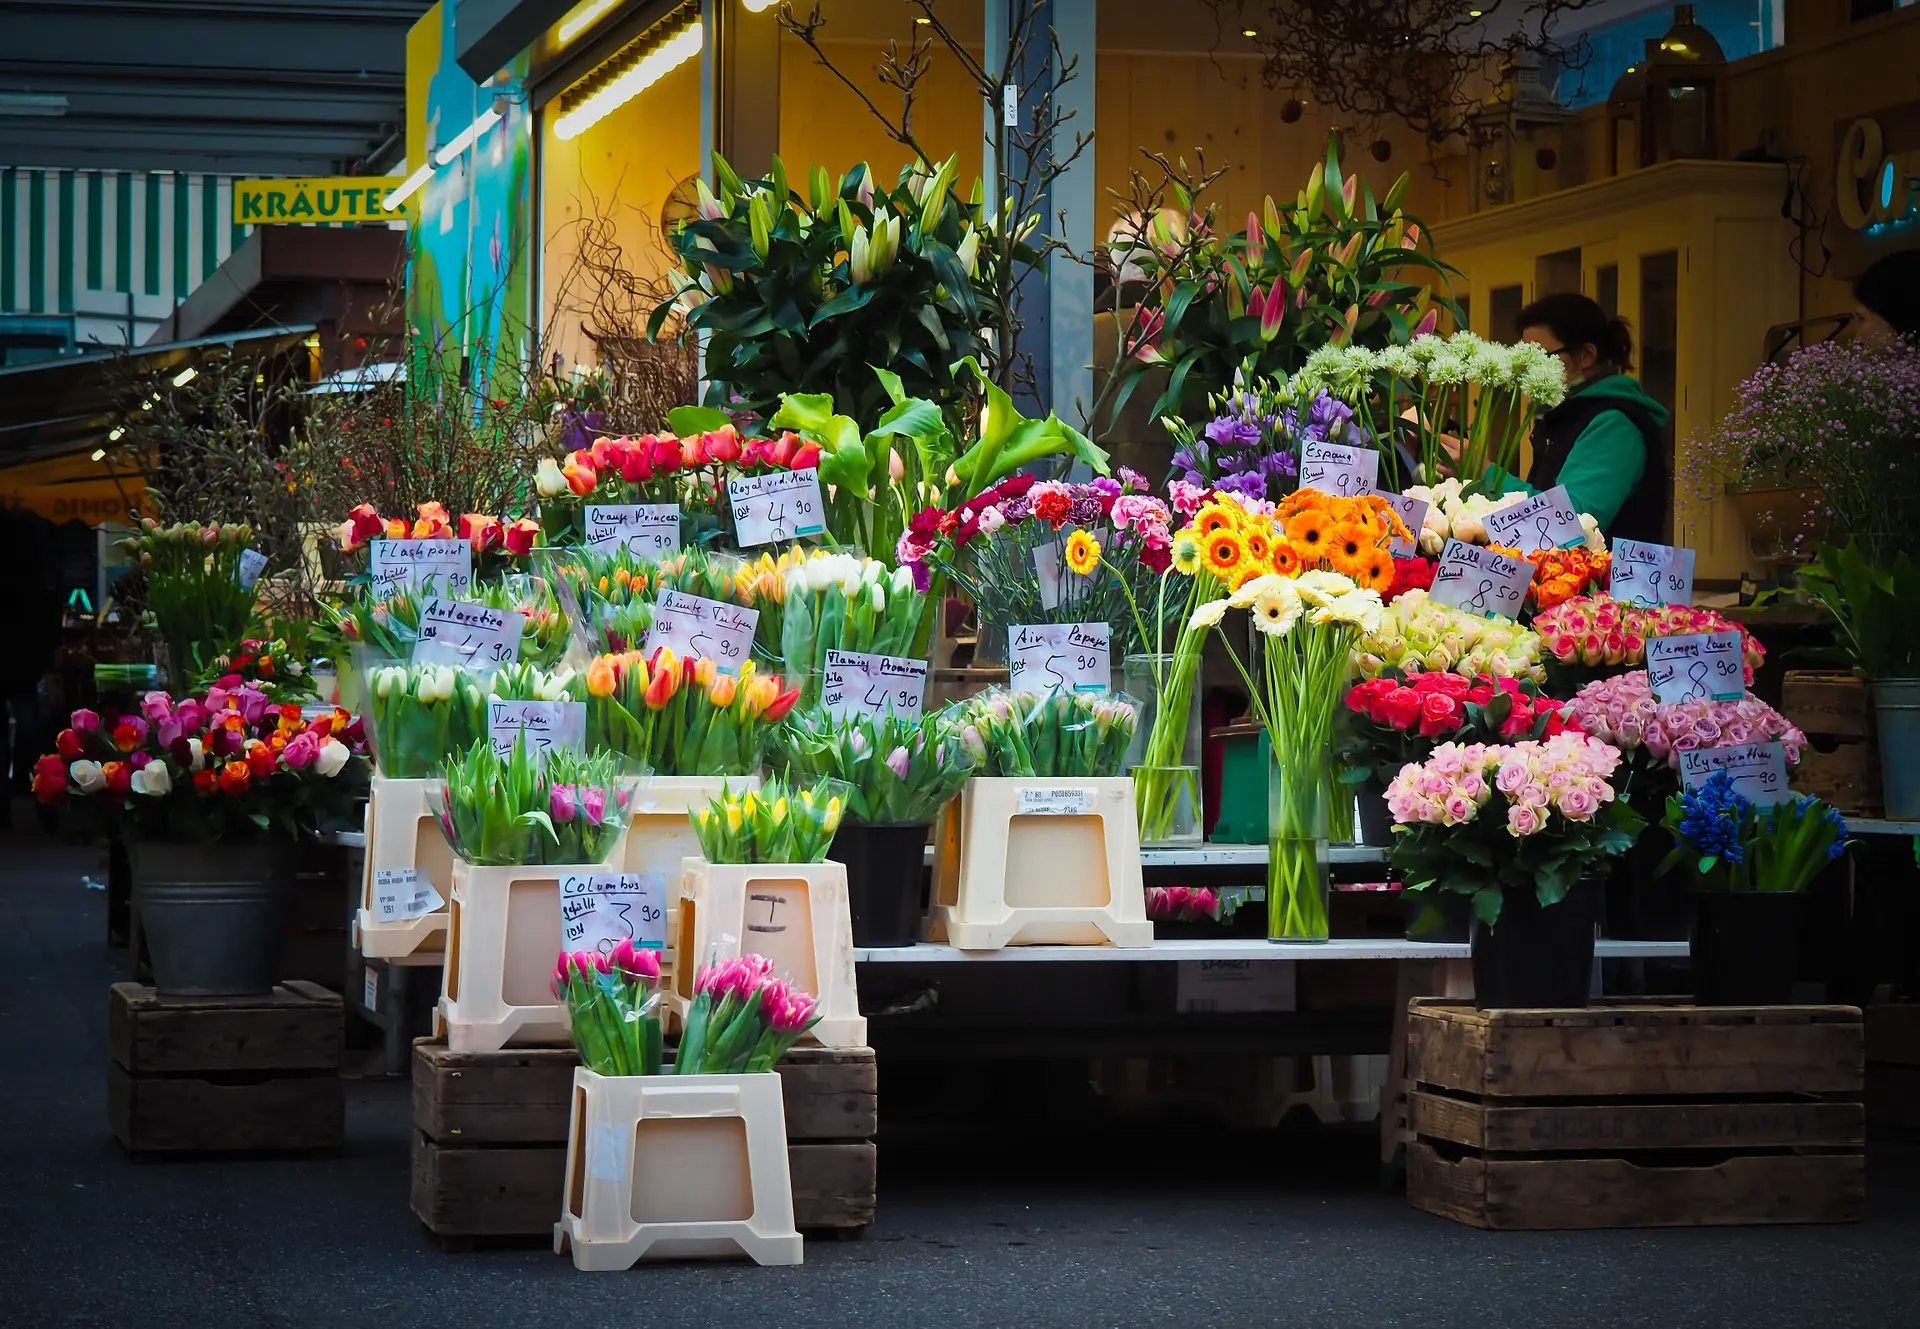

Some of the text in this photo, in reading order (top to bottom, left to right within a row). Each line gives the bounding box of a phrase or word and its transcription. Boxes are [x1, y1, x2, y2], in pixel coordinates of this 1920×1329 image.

[730, 478, 762, 496] Royal
[767, 499, 812, 533] 4 90
[655, 535, 671, 548] 90
[1536, 510, 1575, 551] 8 90
[1438, 566, 1463, 578] Bund
[1447, 542, 1516, 575] Bell Rose
[450, 573, 467, 587] 90
[1472, 580, 1519, 608] 8 50
[1644, 571, 1684, 604] 9 90
[490, 643, 512, 661] 90
[690, 632, 739, 661] 5 90
[1705, 636, 1733, 650] Lane
[1044, 655, 1096, 688] 5 90
[1688, 660, 1737, 697] 8 90
[864, 684, 917, 712] 4 90
[1760, 772, 1776, 784] 90
[564, 876, 640, 893] Columbus
[610, 902, 660, 941] 3 90
